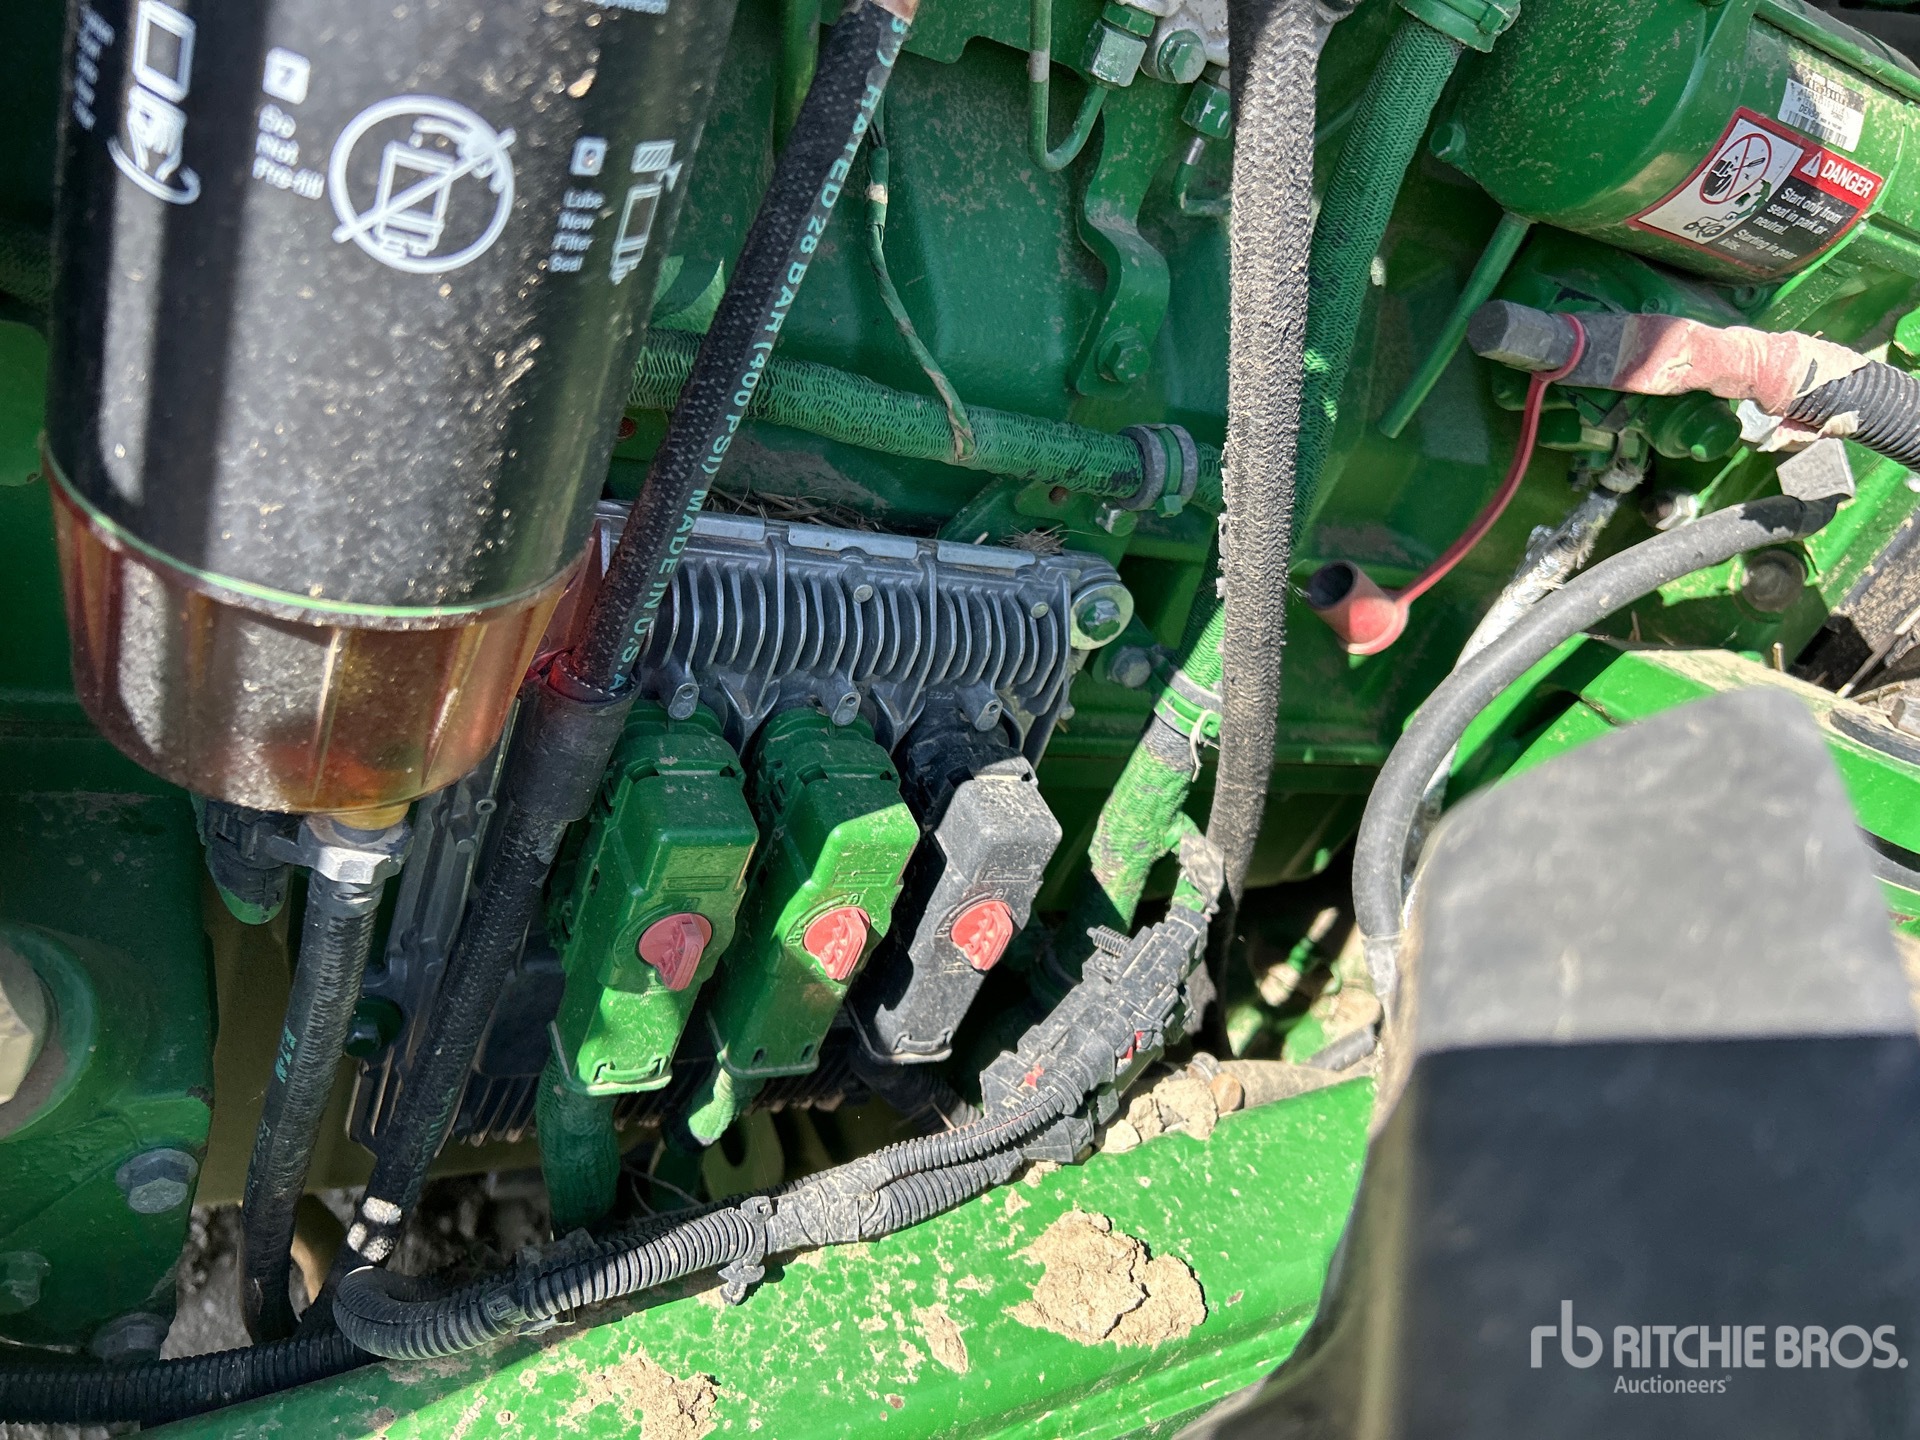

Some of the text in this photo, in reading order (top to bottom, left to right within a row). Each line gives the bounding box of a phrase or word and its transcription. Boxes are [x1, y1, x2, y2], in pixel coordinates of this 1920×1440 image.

[258, 104, 297, 139] Do
[256, 131, 300, 167] Not
[1820, 160, 1875, 199] DANGER
[563, 186, 605, 209] Lube
[1780, 187, 1843, 225] Start only from
[558, 210, 596, 230] New
[800, 215, 827, 254] 28
[1752, 216, 1789, 236] neutral.
[1766, 203, 1828, 235] seat in park or
[551, 232, 593, 253] Filter
[1733, 229, 1798, 260] Starting in gear
[548, 253, 584, 273] Seal
[764, 261, 808, 334] BAR
[733, 341, 773, 407] (400
[701, 414, 741, 474] PSI)
[658, 489, 709, 575] MADE
[643, 582, 669, 609] IN
